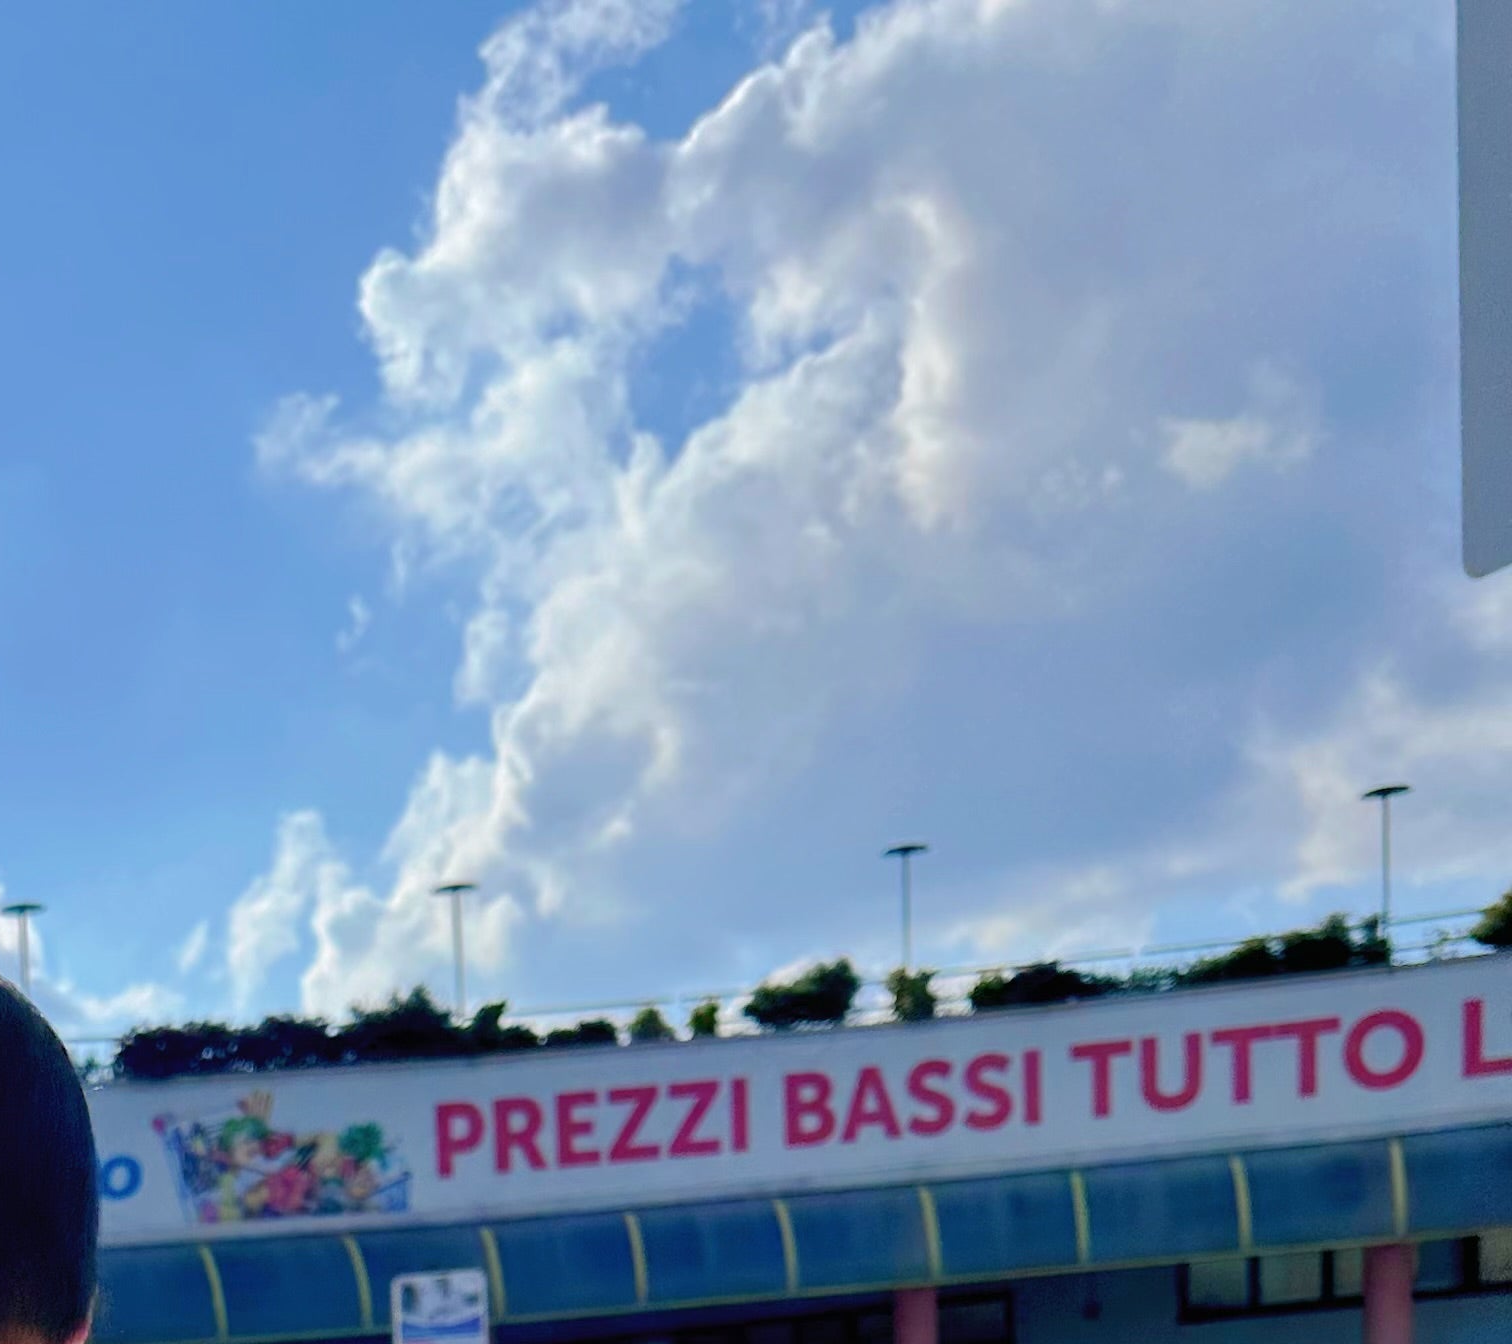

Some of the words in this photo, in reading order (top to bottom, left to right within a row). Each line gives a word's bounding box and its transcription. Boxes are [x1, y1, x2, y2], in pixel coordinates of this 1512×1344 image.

[435, 1076, 750, 1179] PREZZI
[783, 1048, 1043, 1150] BASSI
[1068, 1007, 1426, 1118] TUTTO
